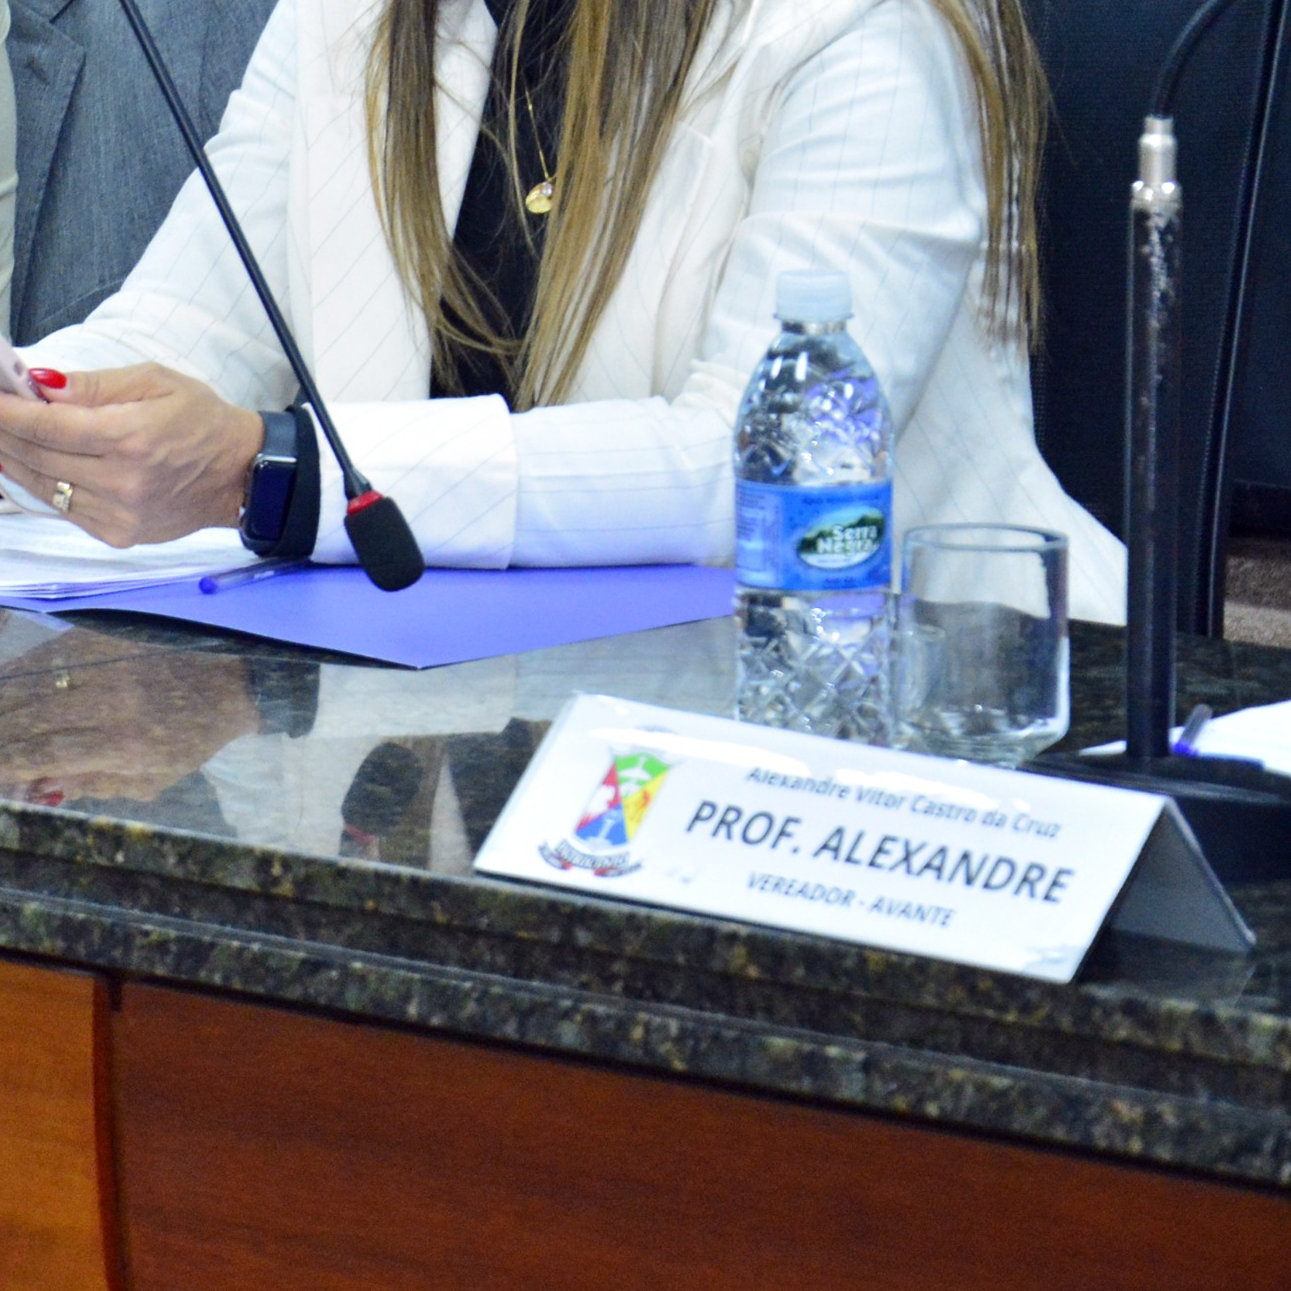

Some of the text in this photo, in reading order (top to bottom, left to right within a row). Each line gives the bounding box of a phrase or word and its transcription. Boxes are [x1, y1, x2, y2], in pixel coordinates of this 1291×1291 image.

[748, 766, 1062, 838] Alexandre Vitor Castro da Cruz
[685, 800, 802, 855] PROF.
[812, 826, 1076, 904] ALEXANDRE
[747, 871, 856, 907] VEREADOR
[870, 895, 956, 926] AVANTE
